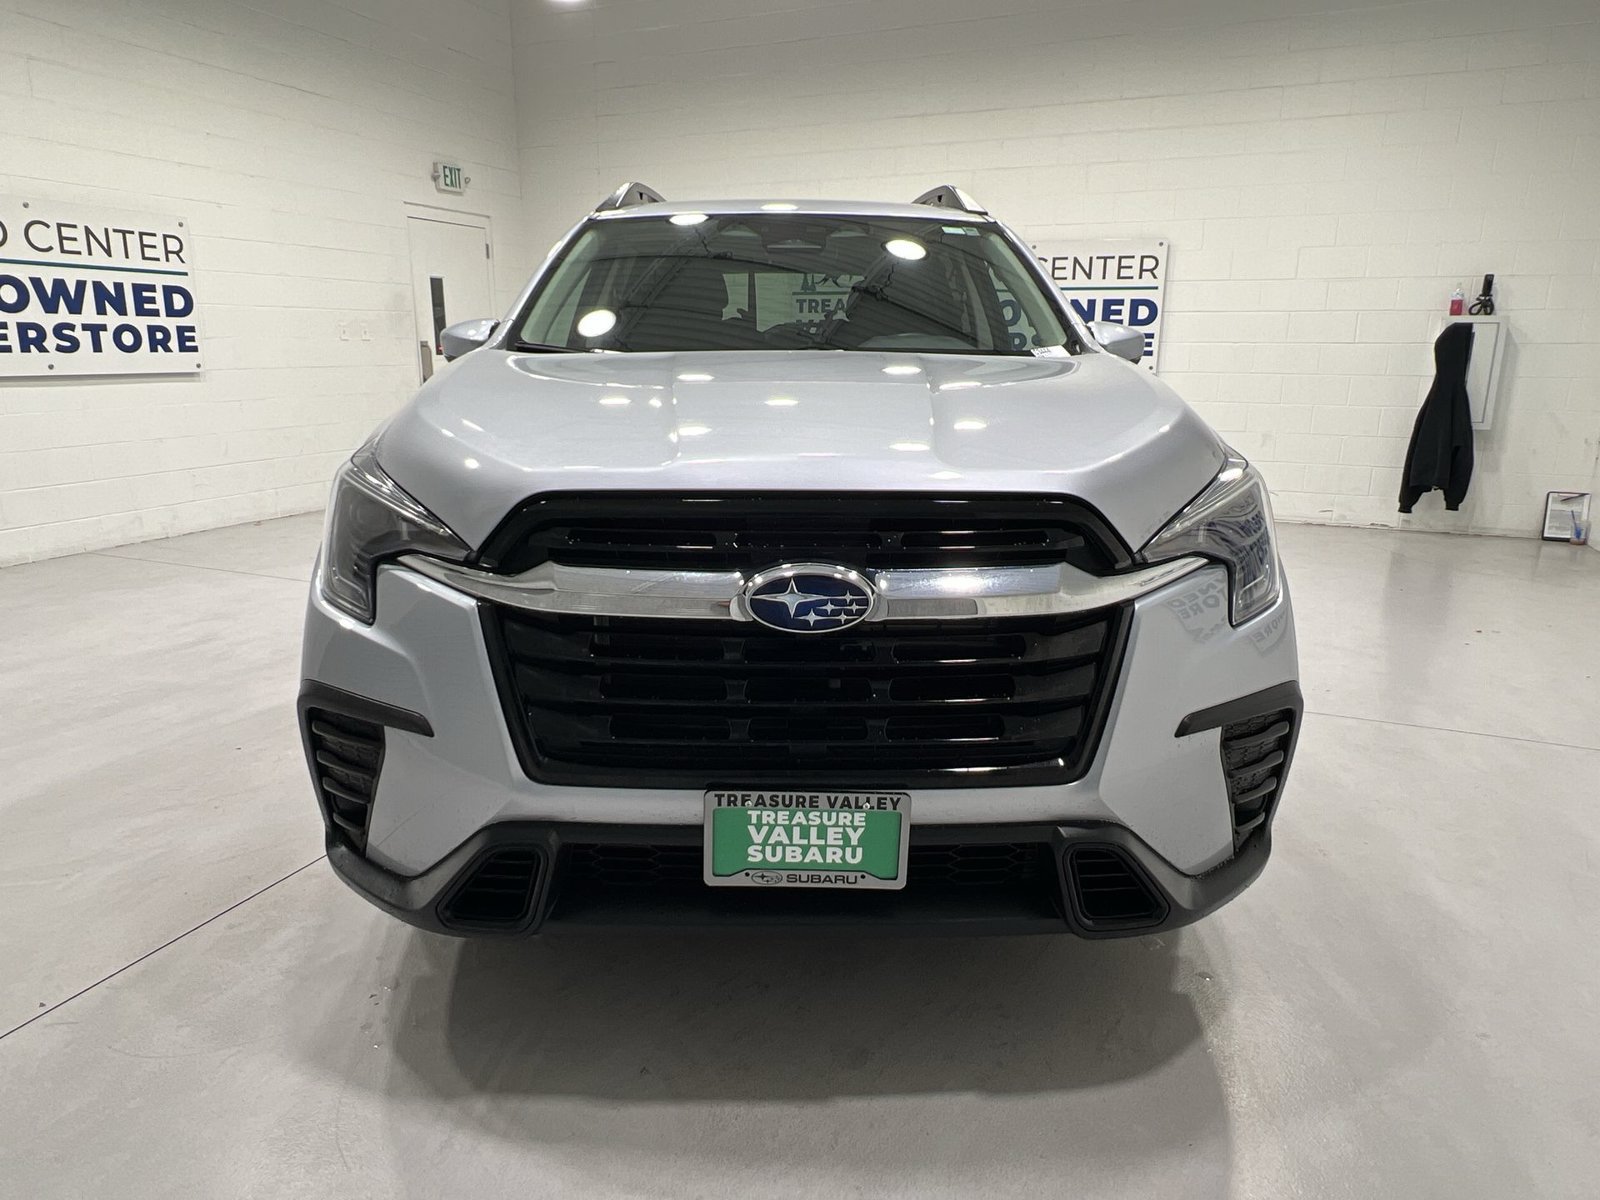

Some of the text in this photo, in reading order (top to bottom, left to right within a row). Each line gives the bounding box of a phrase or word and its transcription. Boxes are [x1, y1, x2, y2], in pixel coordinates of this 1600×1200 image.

[442, 165, 461, 189] EXIT
[23, 220, 186, 264] CENTER
[1038, 255, 1159, 280] ENTER
[0, 274, 194, 318] OWNED
[714, 793, 902, 811] TREASURE VALLEY
[747, 810, 867, 826] TREASURE
[747, 825, 865, 846] VALLEY
[747, 845, 863, 864] SUBARU
[786, 873, 858, 884] SUBARU
